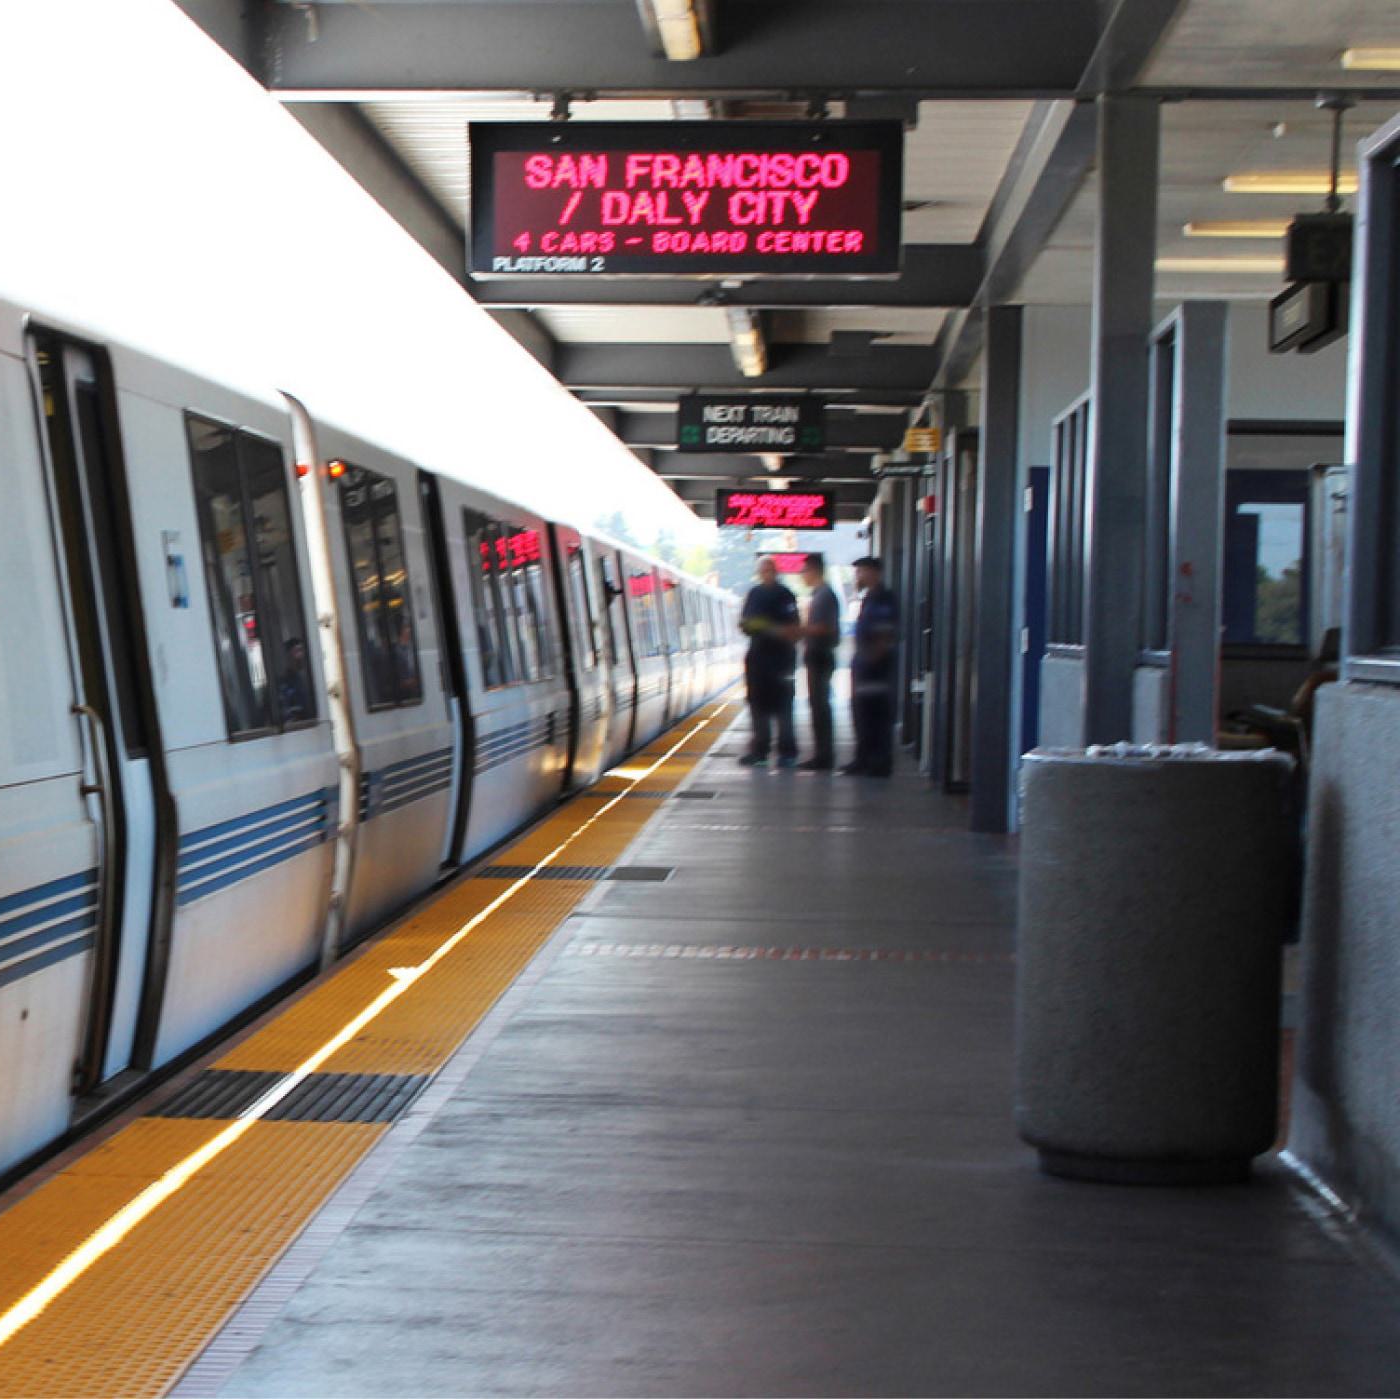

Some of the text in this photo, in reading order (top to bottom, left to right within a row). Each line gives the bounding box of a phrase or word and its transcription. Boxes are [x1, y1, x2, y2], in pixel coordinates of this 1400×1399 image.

[524, 153, 849, 189] SAN FRANCISCO
[558, 190, 818, 225] / DALY CITY
[513, 231, 531, 253] 4
[541, 230, 615, 253] CARS
[652, 230, 747, 253] BOARD
[756, 230, 863, 253] CENTER
[493, 256, 605, 272] PLATFORM 2
[703, 405, 799, 422] NEXT TRAIN
[706, 426, 795, 444] DEPARTING
